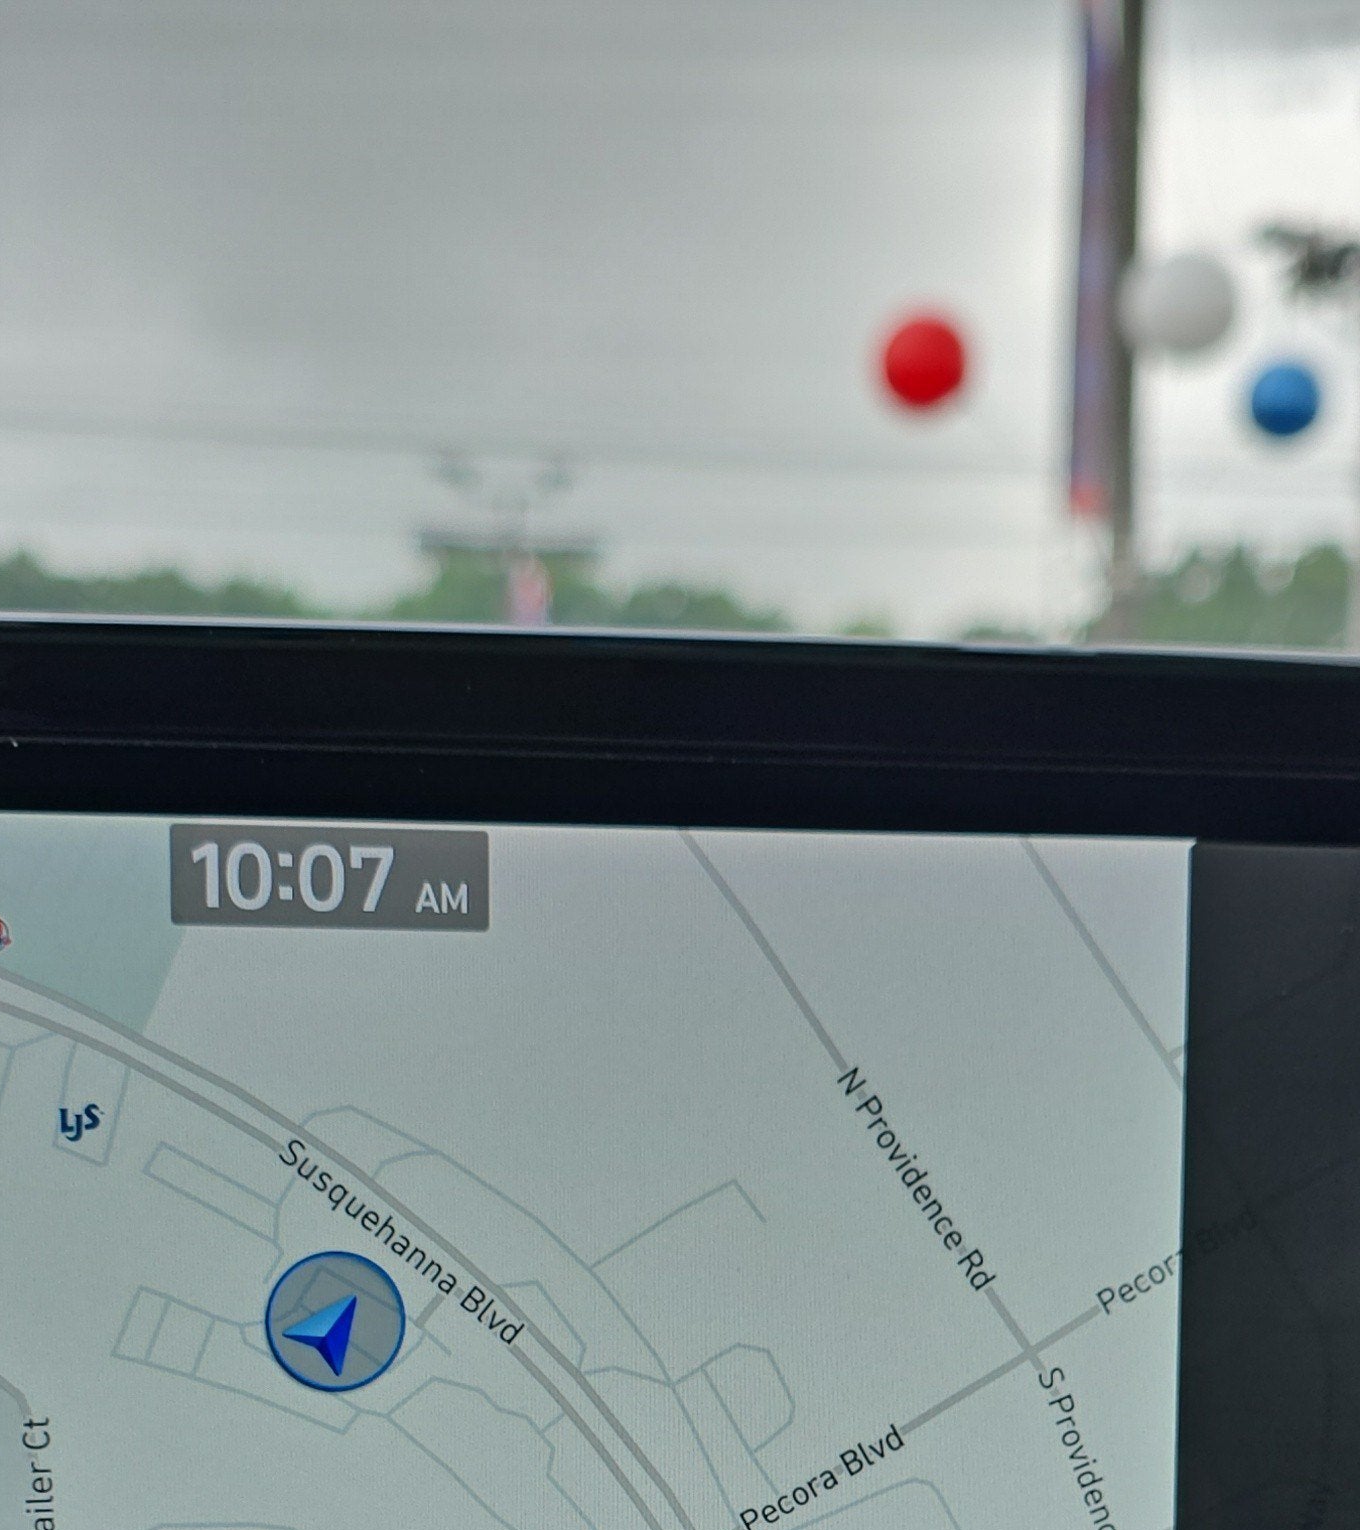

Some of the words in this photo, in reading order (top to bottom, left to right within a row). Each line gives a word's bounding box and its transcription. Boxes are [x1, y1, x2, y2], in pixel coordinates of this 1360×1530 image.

[190, 841, 395, 914] 10:07
[414, 881, 469, 915] AM
[836, 1066, 867, 1096] N
[855, 1094, 964, 1252] Providence
[956, 1248, 997, 1292] Rd
[278, 1138, 458, 1297] Susquehanna
[458, 1285, 526, 1347] Blvd
[1038, 1367, 1065, 1390] S
[22, 1415, 50, 1452] Ct
[839, 1425, 906, 1478] Blvd
